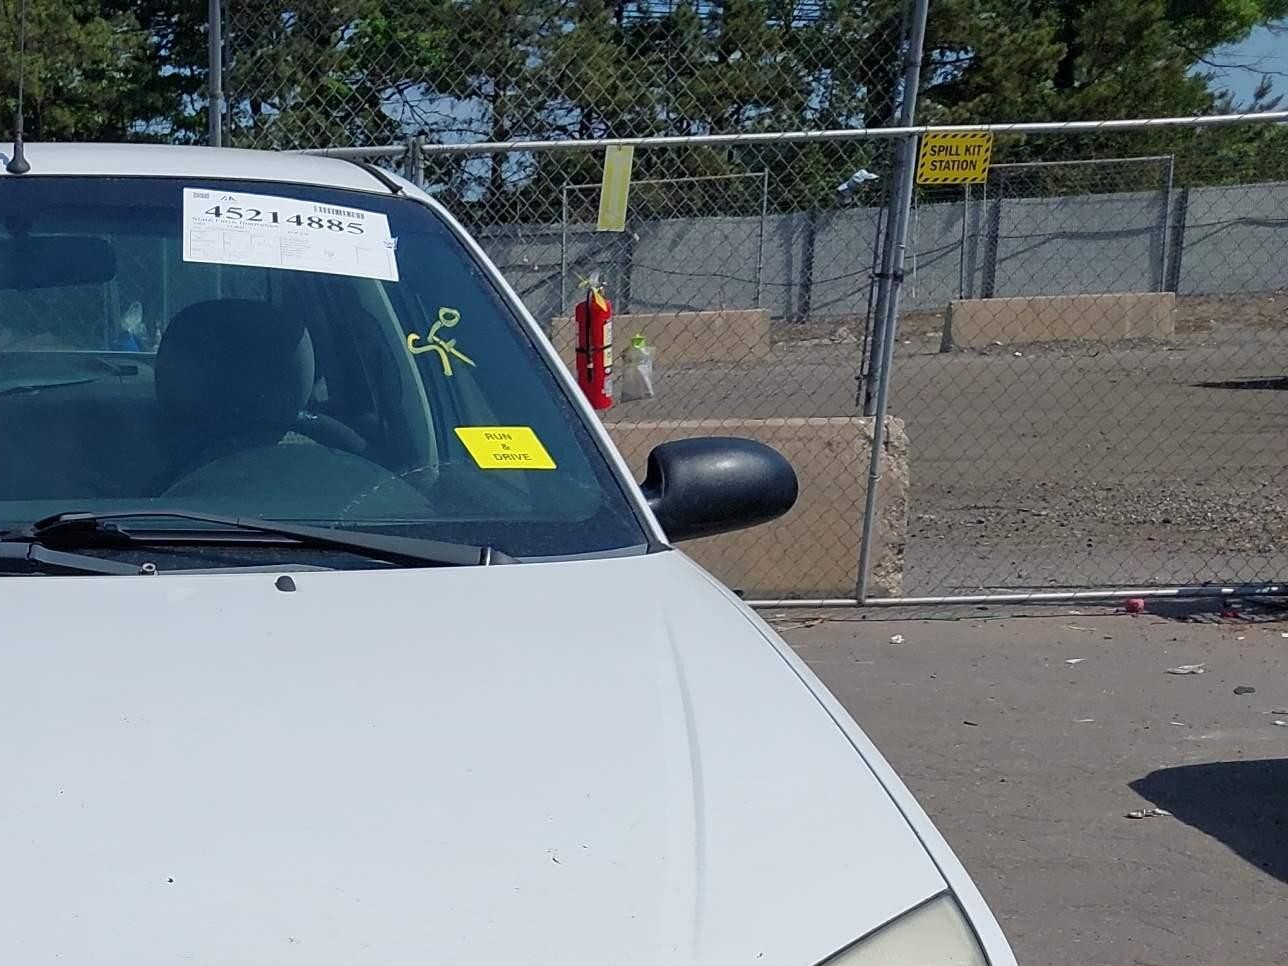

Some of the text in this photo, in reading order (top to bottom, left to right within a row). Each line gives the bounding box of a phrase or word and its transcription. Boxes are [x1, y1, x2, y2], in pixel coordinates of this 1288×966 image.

[930, 144, 984, 156] SPILL KIT
[930, 159, 978, 171] STATION
[205, 205, 366, 235] 45214885
[483, 433, 513, 441] RUN
[493, 453, 532, 461] DRIVE
